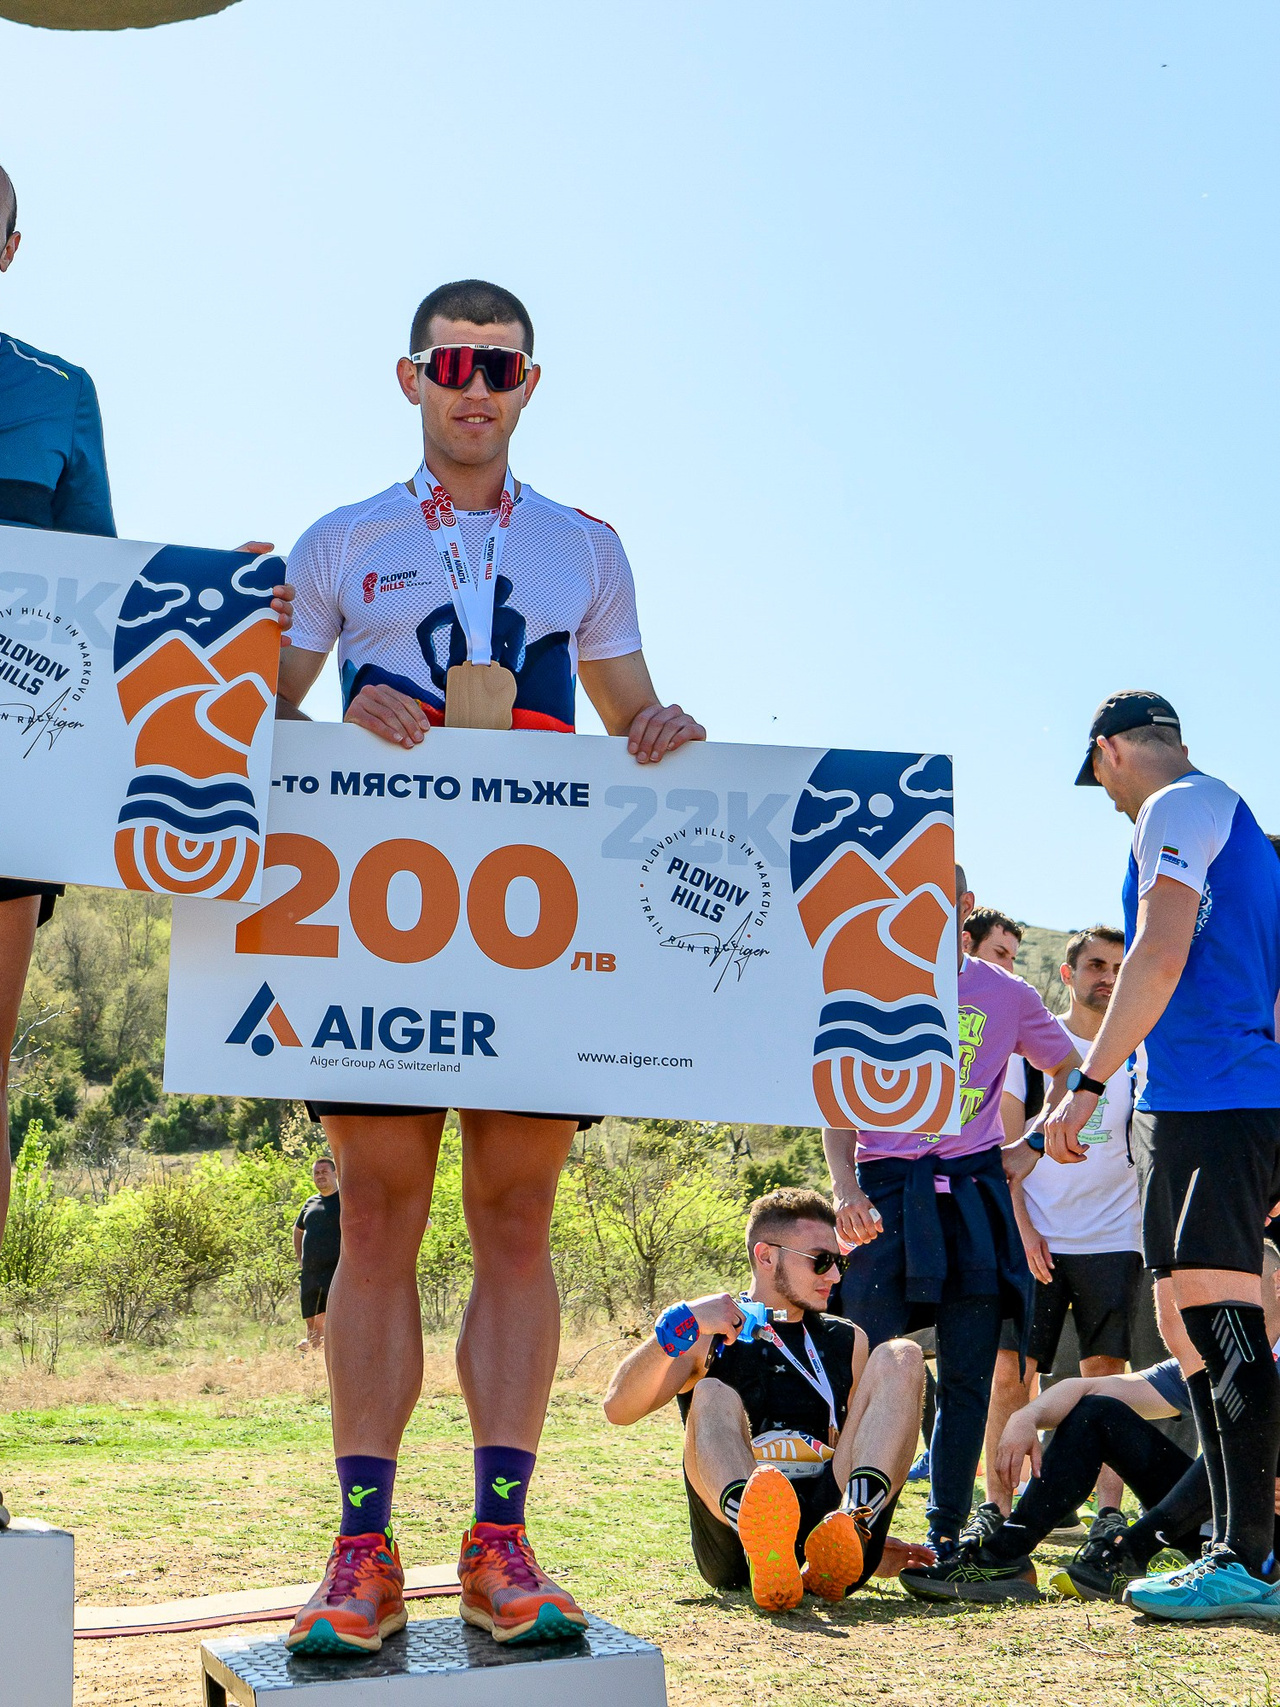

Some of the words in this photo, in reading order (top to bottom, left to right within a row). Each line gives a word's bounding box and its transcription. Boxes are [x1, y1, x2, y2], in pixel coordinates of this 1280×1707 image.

[380, 570, 417, 584] PLOVDIV
[380, 581, 405, 592] HILLS
[21, 607, 62, 624] HILLS
[65, 624, 79, 637] IN
[72, 641, 92, 701] MARKOVO
[271, 775, 320, 794] -то
[330, 771, 461, 801] МЯСТО
[472, 777, 590, 808] МЪЖЕ
[601, 785, 791, 868] 22K
[641, 829, 687, 872] PLOVDIV
[694, 827, 736, 843] HILLS
[740, 843, 754, 857] IN
[754, 860, 771, 926] MARKOVO
[666, 857, 750, 907] PLOVDIV
[235, 832, 578, 970] 200
[640, 897, 664, 935] TRAIL
[670, 885, 726, 923] HILLS
[310, 1004, 499, 1057] AIGER
[310, 1056, 339, 1069] Aiger
[341, 1058, 376, 1071] Group
[378, 1059, 396, 1070] AG
[397, 1059, 461, 1073] Switzerland
[577, 1051, 693, 1069] www.aiger.com
